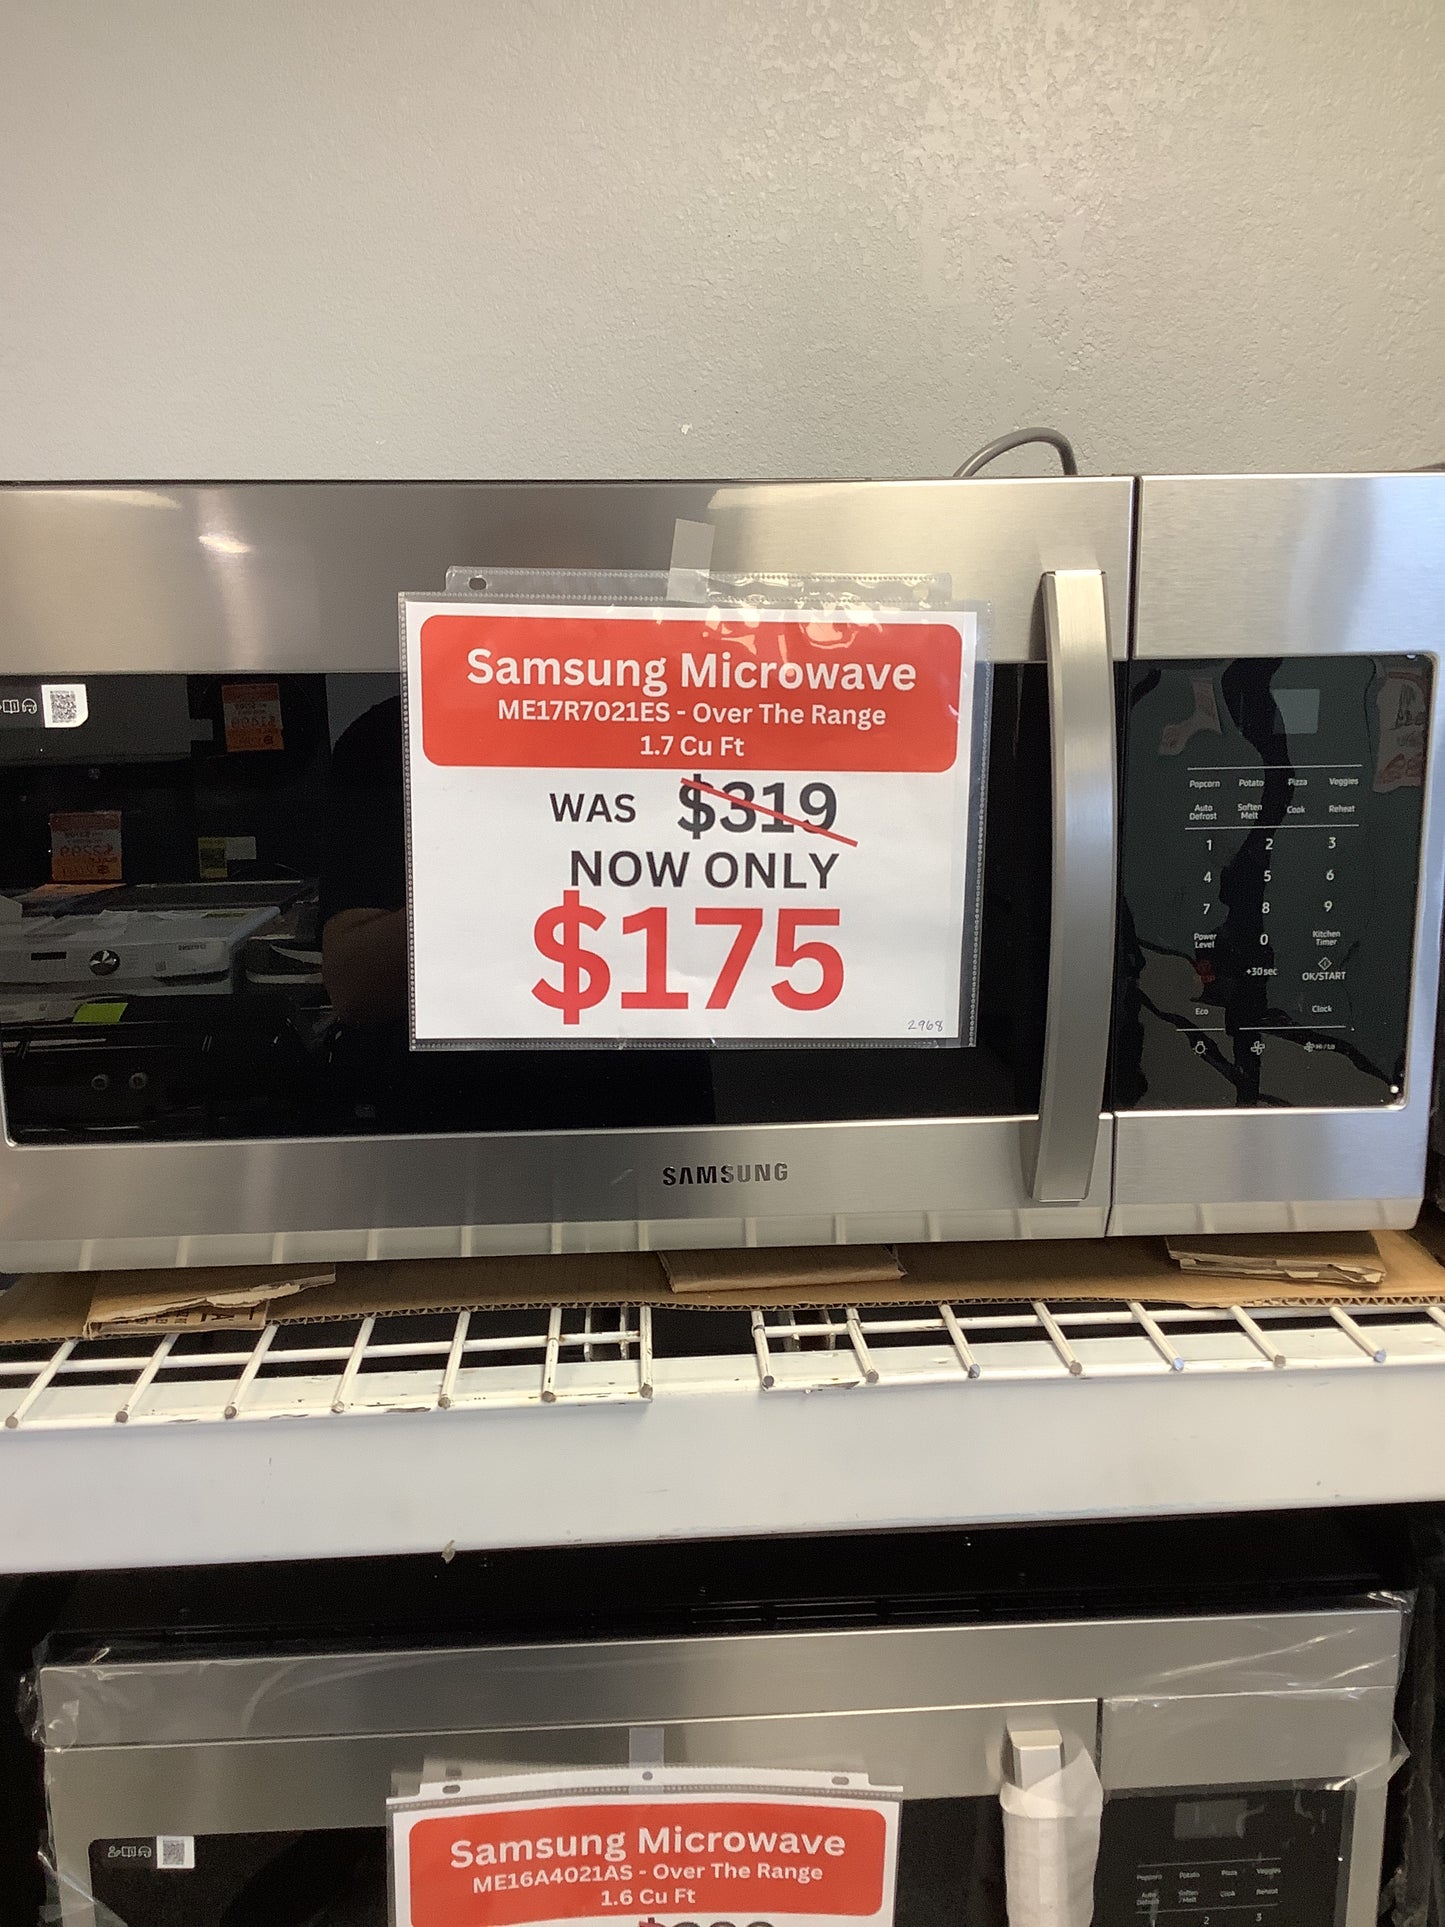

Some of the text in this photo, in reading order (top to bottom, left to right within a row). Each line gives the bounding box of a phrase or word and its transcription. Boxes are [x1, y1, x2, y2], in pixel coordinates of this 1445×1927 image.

[466, 648, 917, 695] Samsung Microwave
[498, 699, 671, 723] ME17R7021ES
[692, 703, 753, 724] Over
[760, 704, 806, 725] The
[811, 705, 887, 730] Range
[640, 735, 744, 757] 1.7 Cu Ft
[1189, 780, 1220, 789] Popcorn
[1239, 779, 1265, 787] Potato
[1288, 778, 1307, 786] Pizza
[1329, 777, 1359, 787] Veggies
[549, 773, 837, 839] WAS $319
[1194, 804, 1213, 812] Auto
[1238, 803, 1263, 812] Soften
[1287, 805, 1306, 814] Cook
[1329, 805, 1355, 813] Reheat
[1189, 812, 1217, 820] Defrost
[1206, 839, 1212, 851] 1
[1265, 838, 1273, 850] 2
[1328, 837, 1336, 849] 3
[571, 850, 839, 890] NOW ONLY
[1326, 869, 1334, 881] 6
[1203, 872, 1212, 882] 4
[1264, 870, 1271, 882] 5
[1203, 903, 1210, 915] 7
[1262, 902, 1270, 914] 8
[1325, 901, 1333, 912] 9
[1194, 933, 1217, 941] Power
[1260, 934, 1268, 945] 0
[1312, 930, 1341, 938] Kitchen
[1195, 941, 1215, 949] Level
[531, 890, 845, 1025] $175
[1302, 972, 1346, 981] OK/START
[1312, 1005, 1332, 1013] Clock
[908, 1019, 943, 1032] 2968
[662, 1162, 788, 1186] SAMSUNG
[450, 1826, 846, 1869] Samsung Microwave
[473, 1865, 634, 1893] ME16A4021AS
[653, 1863, 704, 1880] Over
[712, 1863, 751, 1880] The
[757, 1863, 823, 1883] Range
[601, 1888, 696, 1906] 1.6 Cu Ft
[1203, 1916, 1210, 1925] 2
[1255, 1912, 1262, 1921] 3
